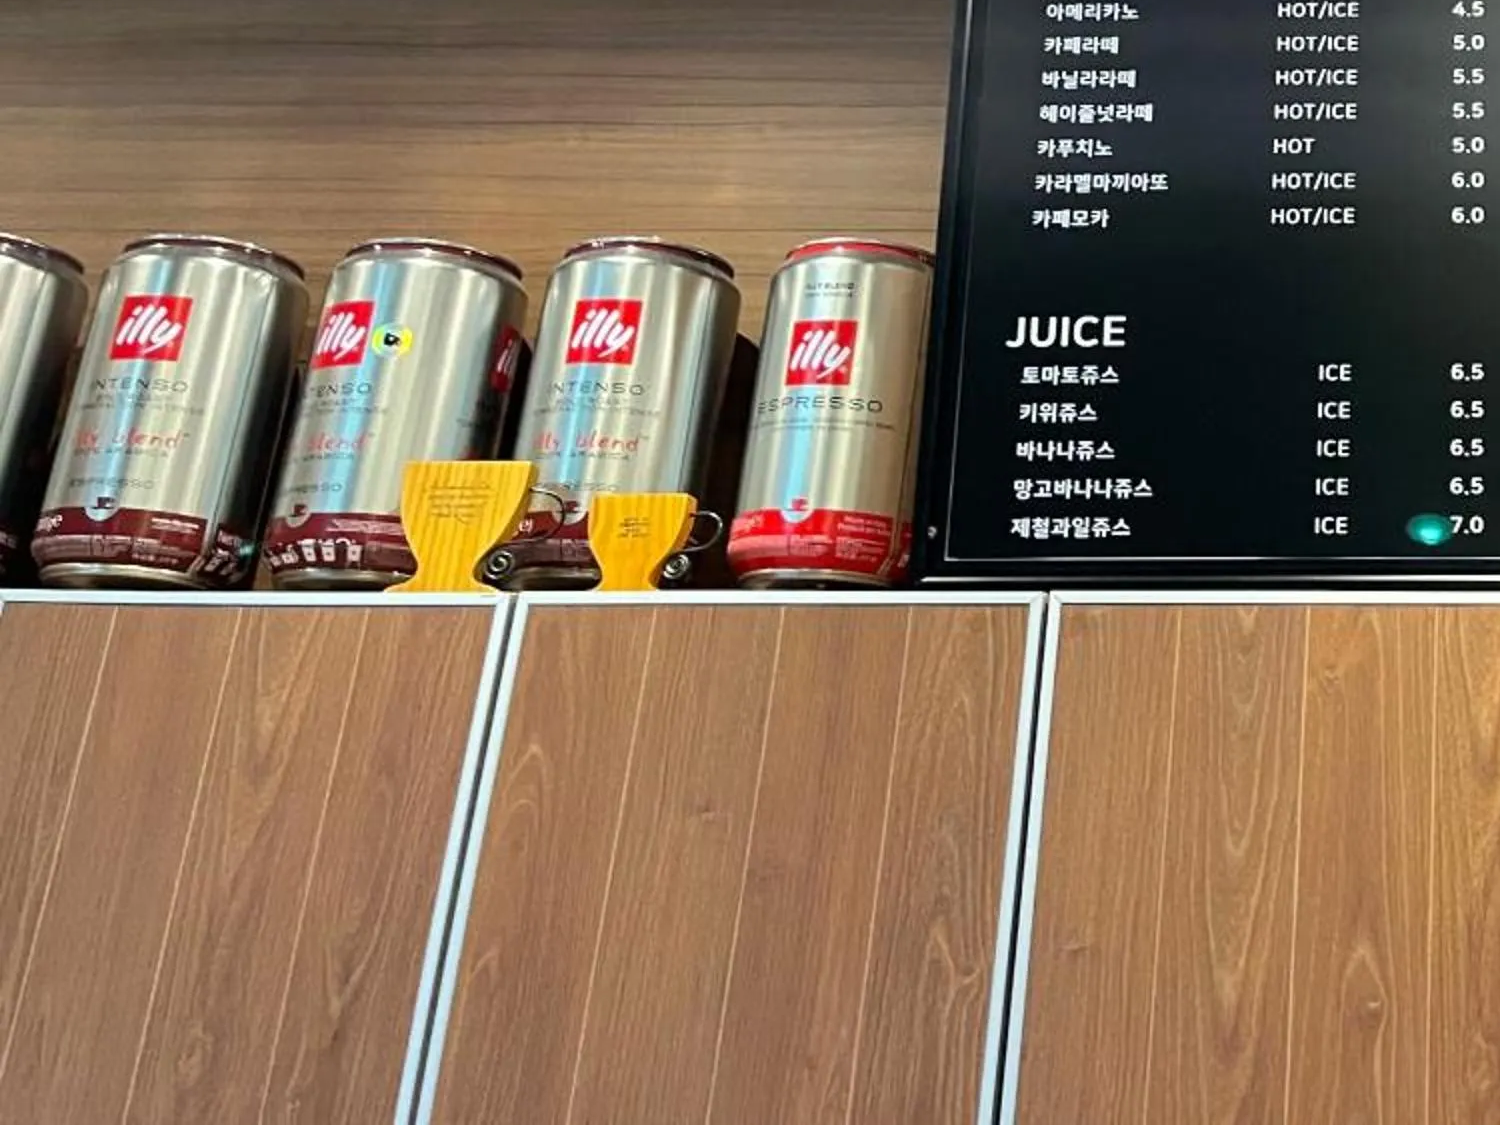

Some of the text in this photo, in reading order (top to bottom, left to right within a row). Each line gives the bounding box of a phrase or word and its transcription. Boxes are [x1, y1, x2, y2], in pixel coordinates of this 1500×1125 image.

[1046, 0, 1485, 22] 아메리카노 HOT/ICE 4.5
[1044, 34, 1485, 55] 카페라떼 HOT/ICE 5.0
[1041, 68, 1485, 90] 바닐라라떼 HOT/ICE 5.5
[1274, 102, 1357, 121] HOT/ICE
[1452, 101, 1485, 119] 5.5
[1037, 136, 1485, 158] 카푸치노 HOT 5.0
[1035, 171, 1485, 194] 카라멜마끼아또 HOT/ICE 6.0
[1032, 206, 1485, 229] 카페모카 HOT/ICE 6.0
[116, 305, 182, 355] illy
[316, 311, 365, 360] illy
[570, 308, 636, 357] illy
[1005, 315, 1127, 348] JUICE
[789, 329, 852, 380] illy
[1020, 362, 1485, 386] 토마토쥬스 ICE 6.5
[757, 395, 883, 415] ESPRESSO
[1019, 400, 1485, 424] 키위쥬스 ICE 6.5
[1016, 438, 1485, 462] 바나나쥬스 ICE 6.5
[1013, 476, 1485, 500] 망고바나나쥬스 ICE 6.5
[1010, 515, 1485, 540] 제철과일쥬스 ICE 7.0
